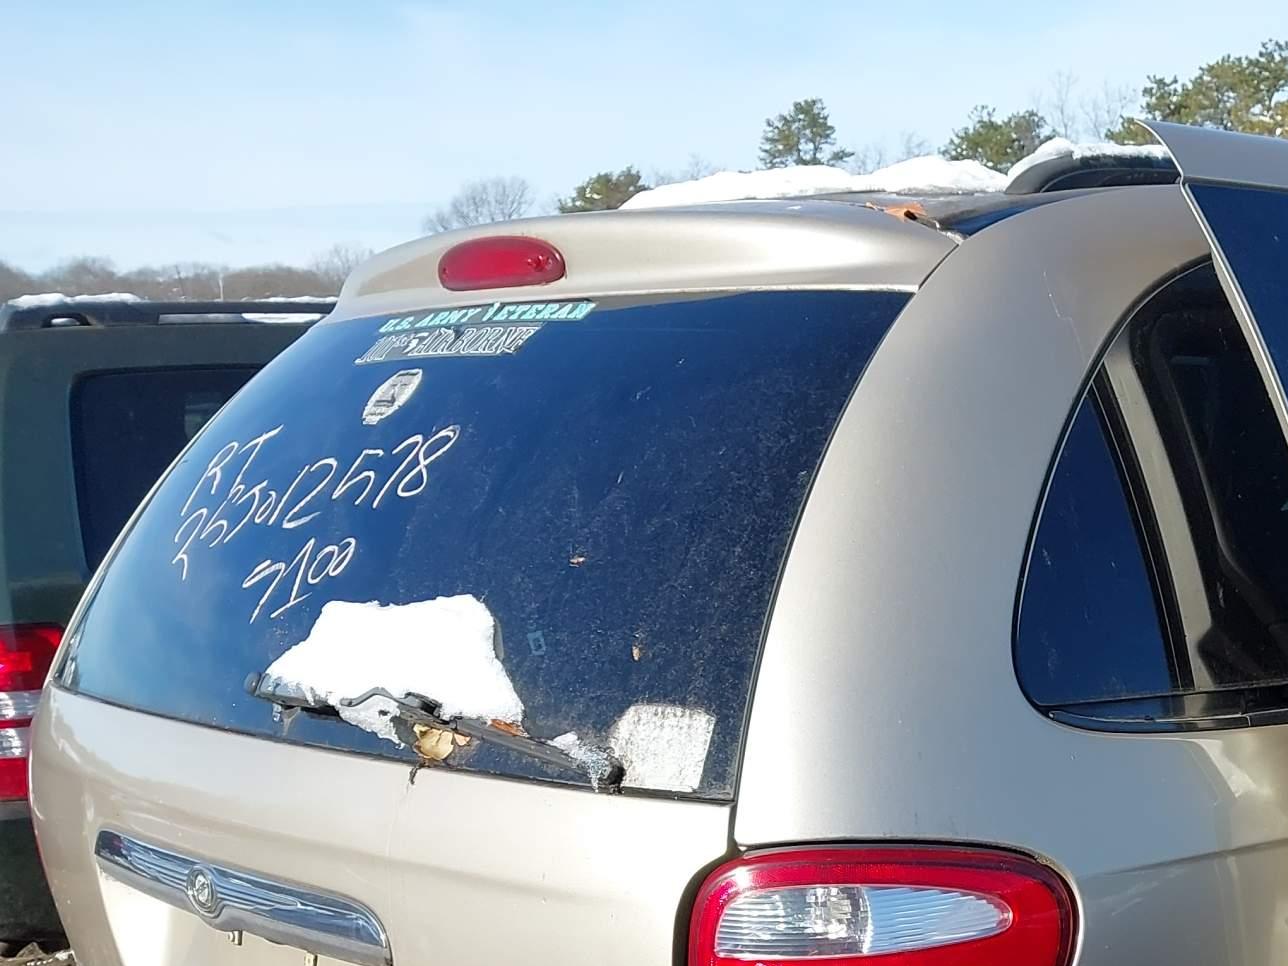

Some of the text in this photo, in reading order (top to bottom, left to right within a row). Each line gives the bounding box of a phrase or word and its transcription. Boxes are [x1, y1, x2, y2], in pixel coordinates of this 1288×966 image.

[379, 301, 597, 333] U.S. ARMY VETERAN
[408, 326, 541, 356] AIRBORNE
